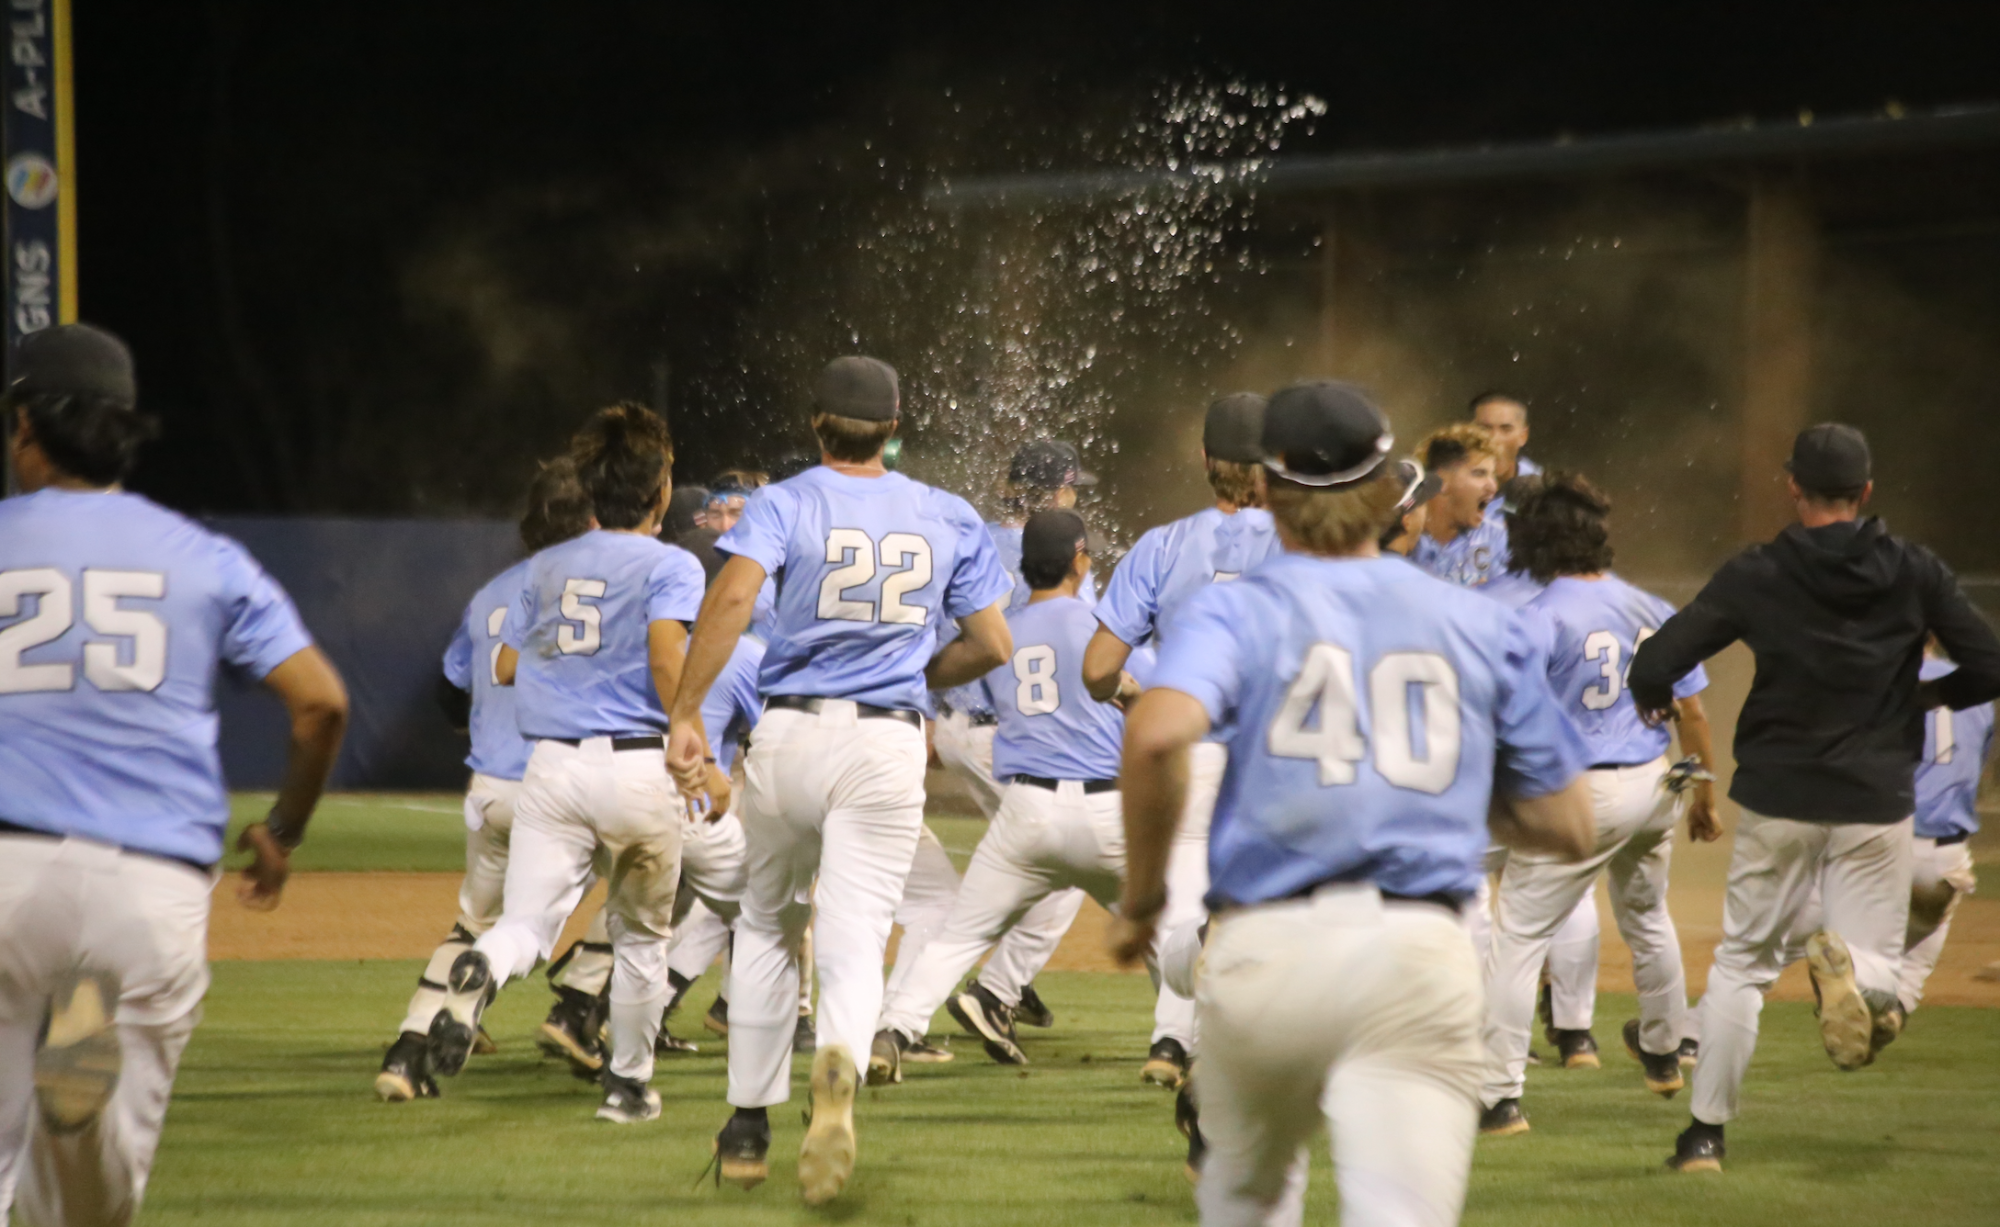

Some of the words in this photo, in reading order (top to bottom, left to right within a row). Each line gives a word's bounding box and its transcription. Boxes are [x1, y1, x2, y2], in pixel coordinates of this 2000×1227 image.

[11, 0, 47, 121] A-PL
[15, 240, 51, 338] GNS
[557, 577, 607, 656] 5
[815, 527, 932, 626] 22
[0, 567, 168, 694] 25
[1012, 643, 1060, 717] 8
[1267, 641, 1462, 796] 40
